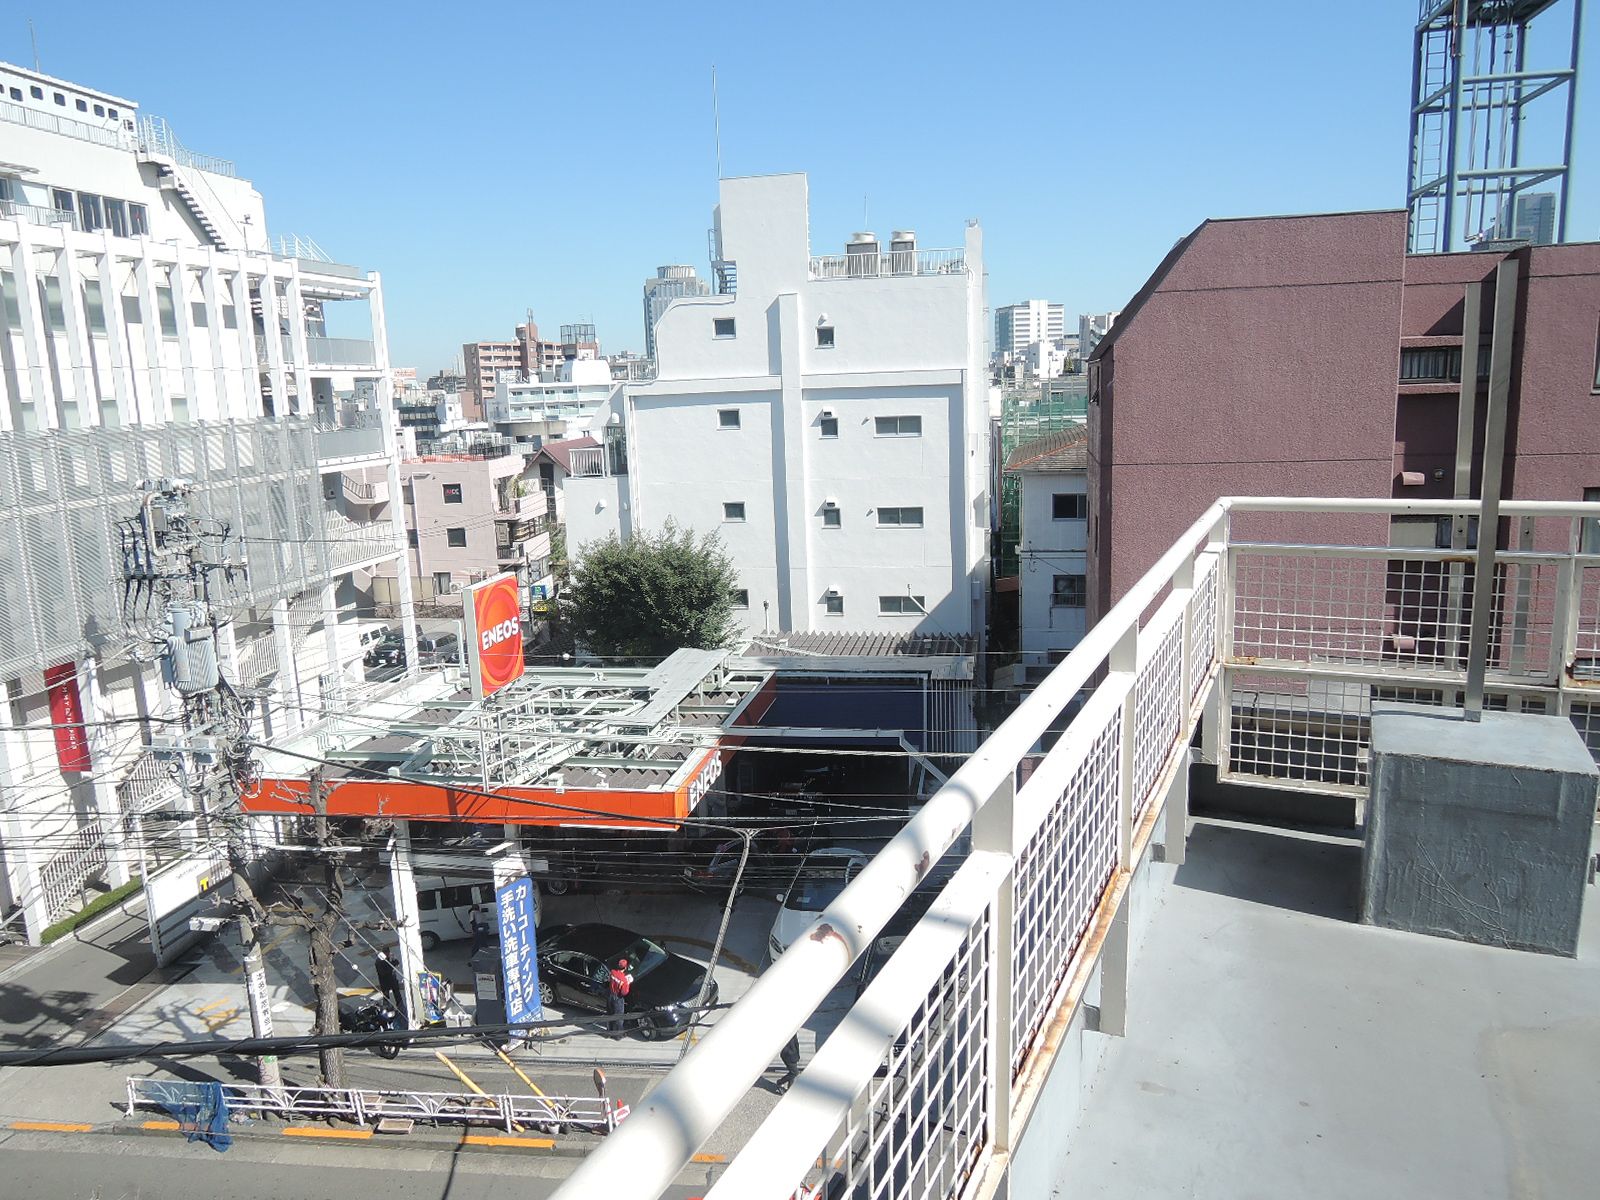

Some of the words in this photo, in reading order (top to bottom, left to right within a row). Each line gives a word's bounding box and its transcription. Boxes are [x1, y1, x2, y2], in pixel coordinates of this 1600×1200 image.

[481, 616, 519, 651] ENEOS
[688, 750, 722, 812] ENEOS
[500, 889, 523, 1017] 手洗い洗車専門店
[515, 884, 534, 1003] カーコーティング
